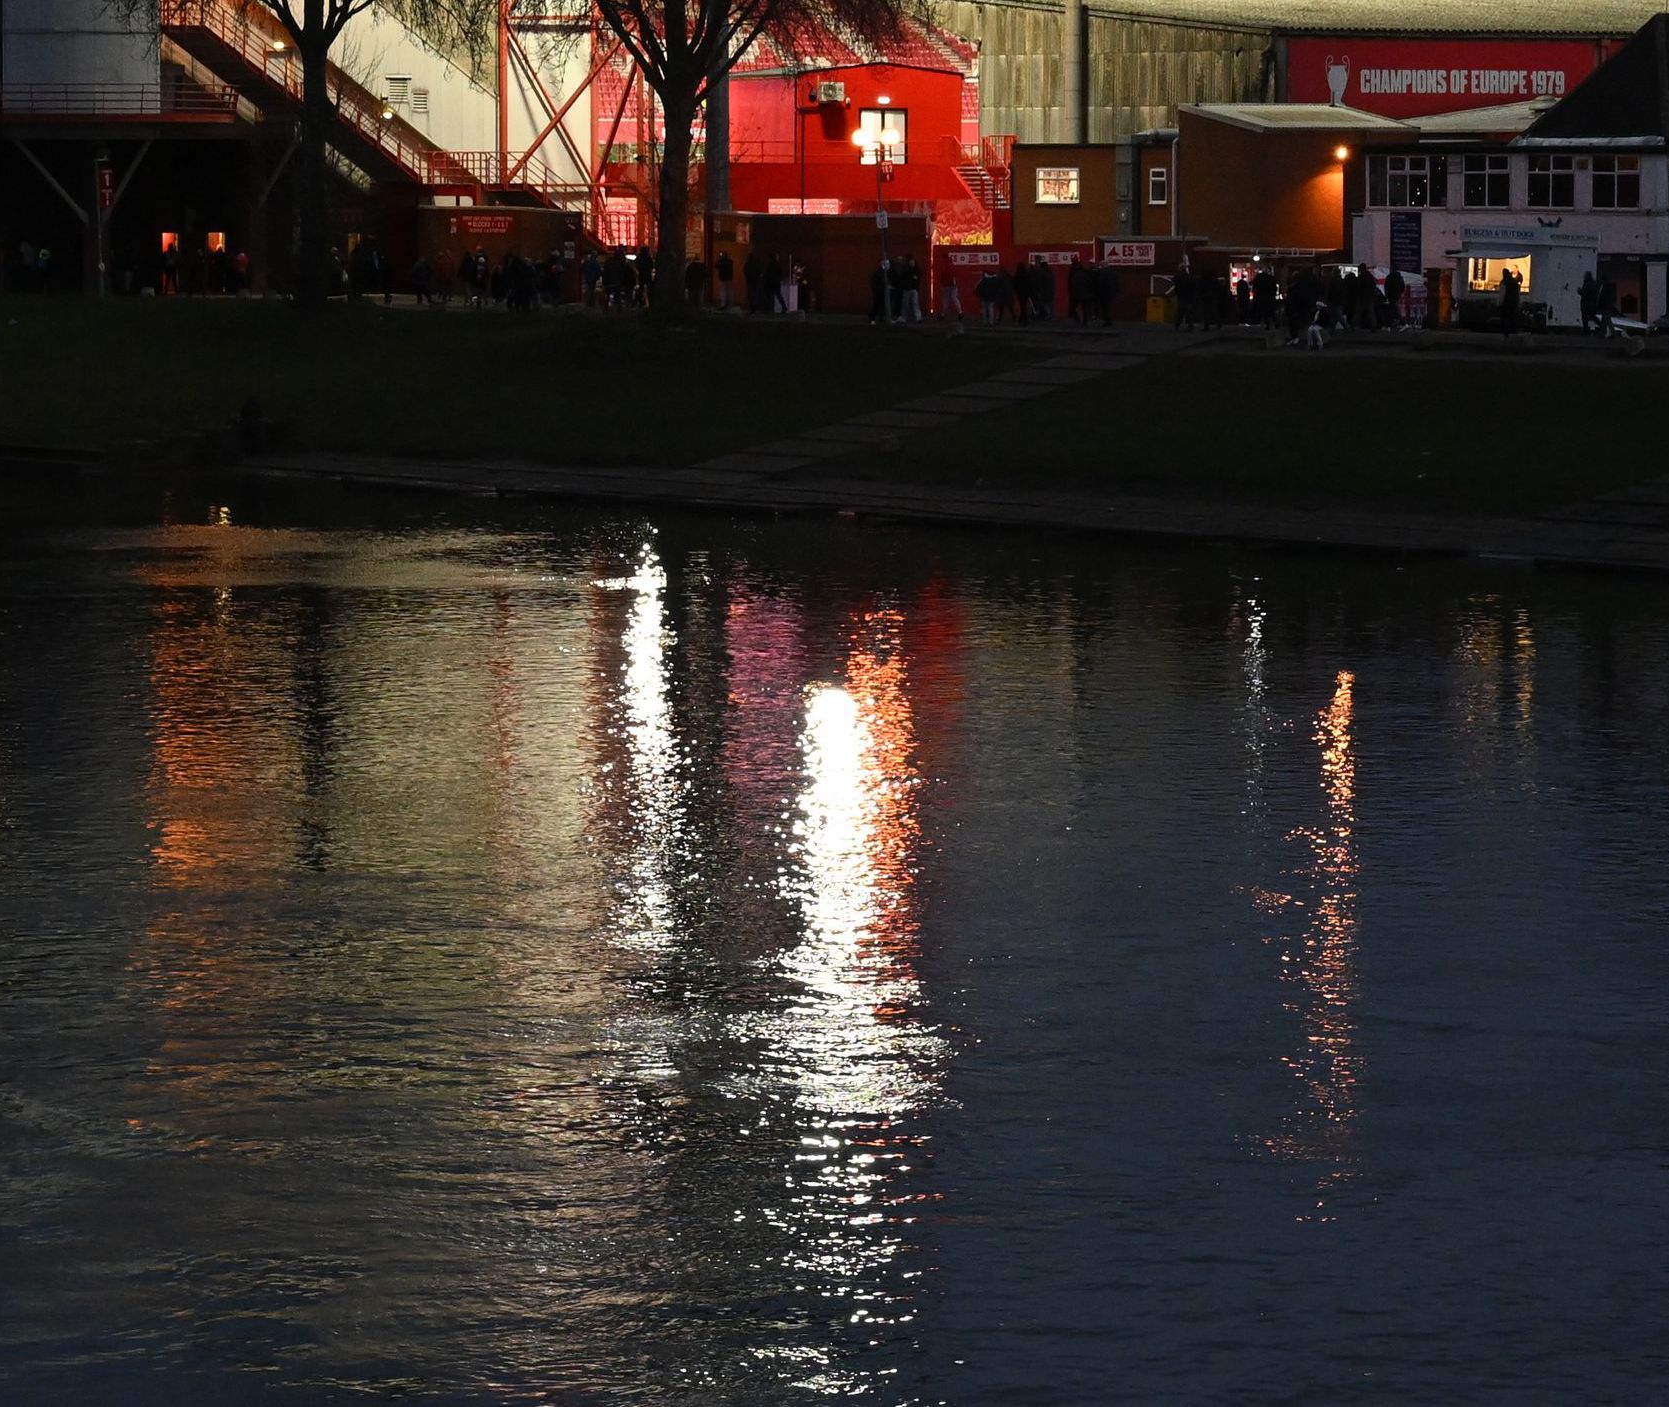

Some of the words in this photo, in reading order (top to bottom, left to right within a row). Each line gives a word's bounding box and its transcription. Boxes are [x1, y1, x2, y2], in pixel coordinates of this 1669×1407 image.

[1360, 69, 1447, 94] CHAMPIONS
[1450, 69, 1468, 94] OF
[1471, 70, 1527, 95] EUROPE
[1531, 70, 1565, 95] 1979
